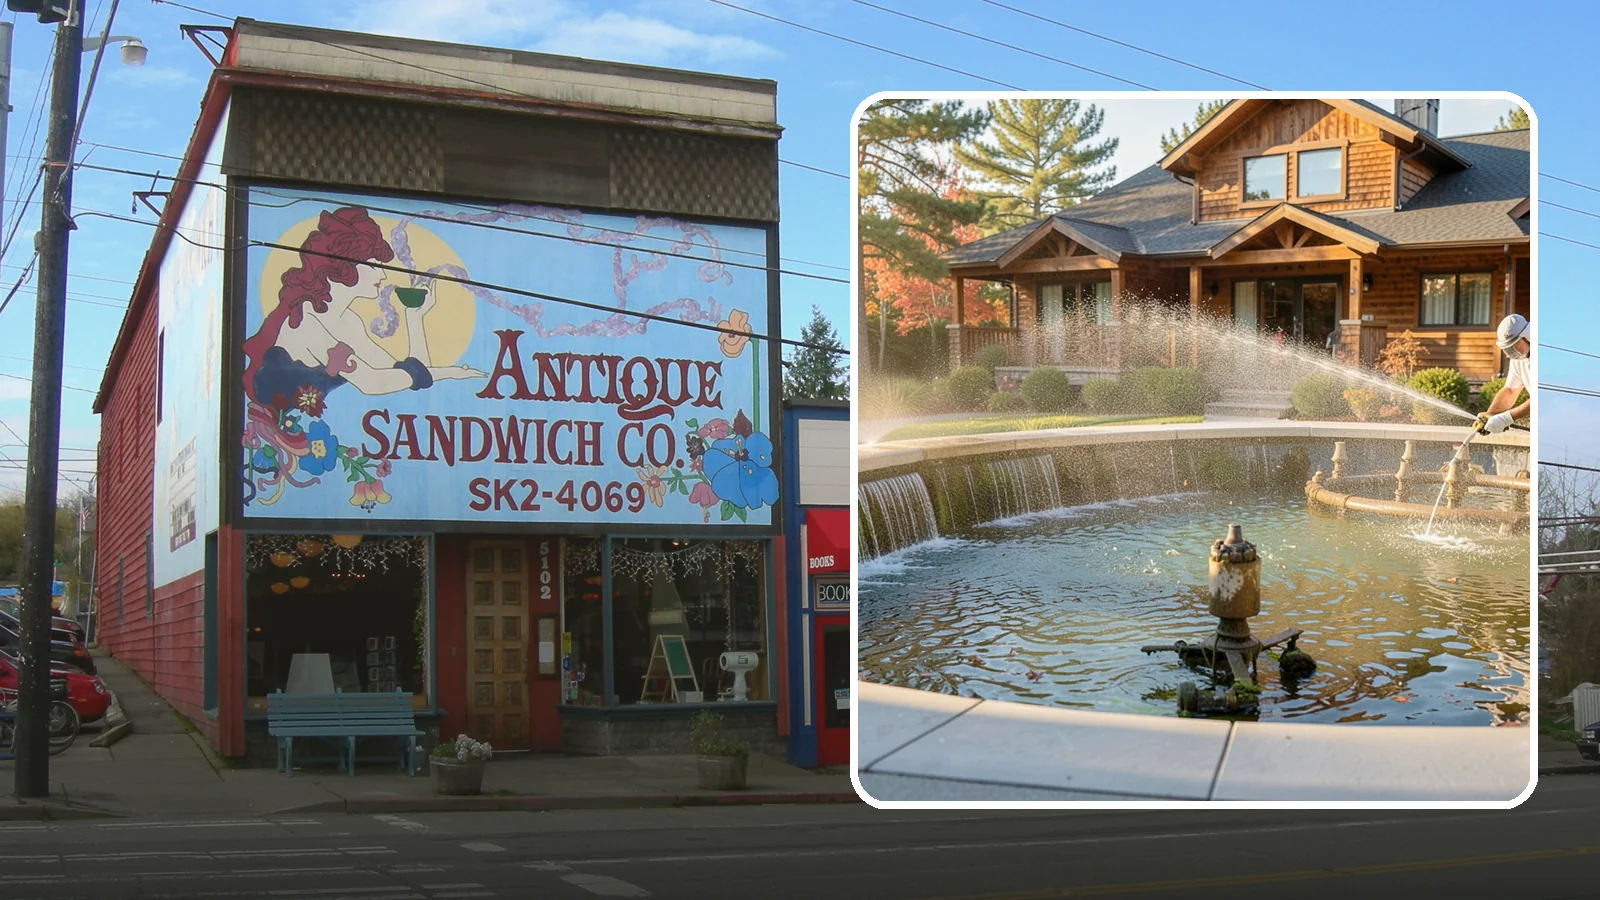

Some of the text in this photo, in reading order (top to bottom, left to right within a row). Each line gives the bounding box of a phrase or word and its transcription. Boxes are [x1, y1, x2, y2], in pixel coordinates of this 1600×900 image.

[476, 329, 724, 421] ANTIQUE
[362, 409, 685, 469] SANDWICH CO.
[468, 477, 646, 513] SK2-4069
[540, 541, 552, 599] 5102
[810, 555, 835, 569] BOOKS
